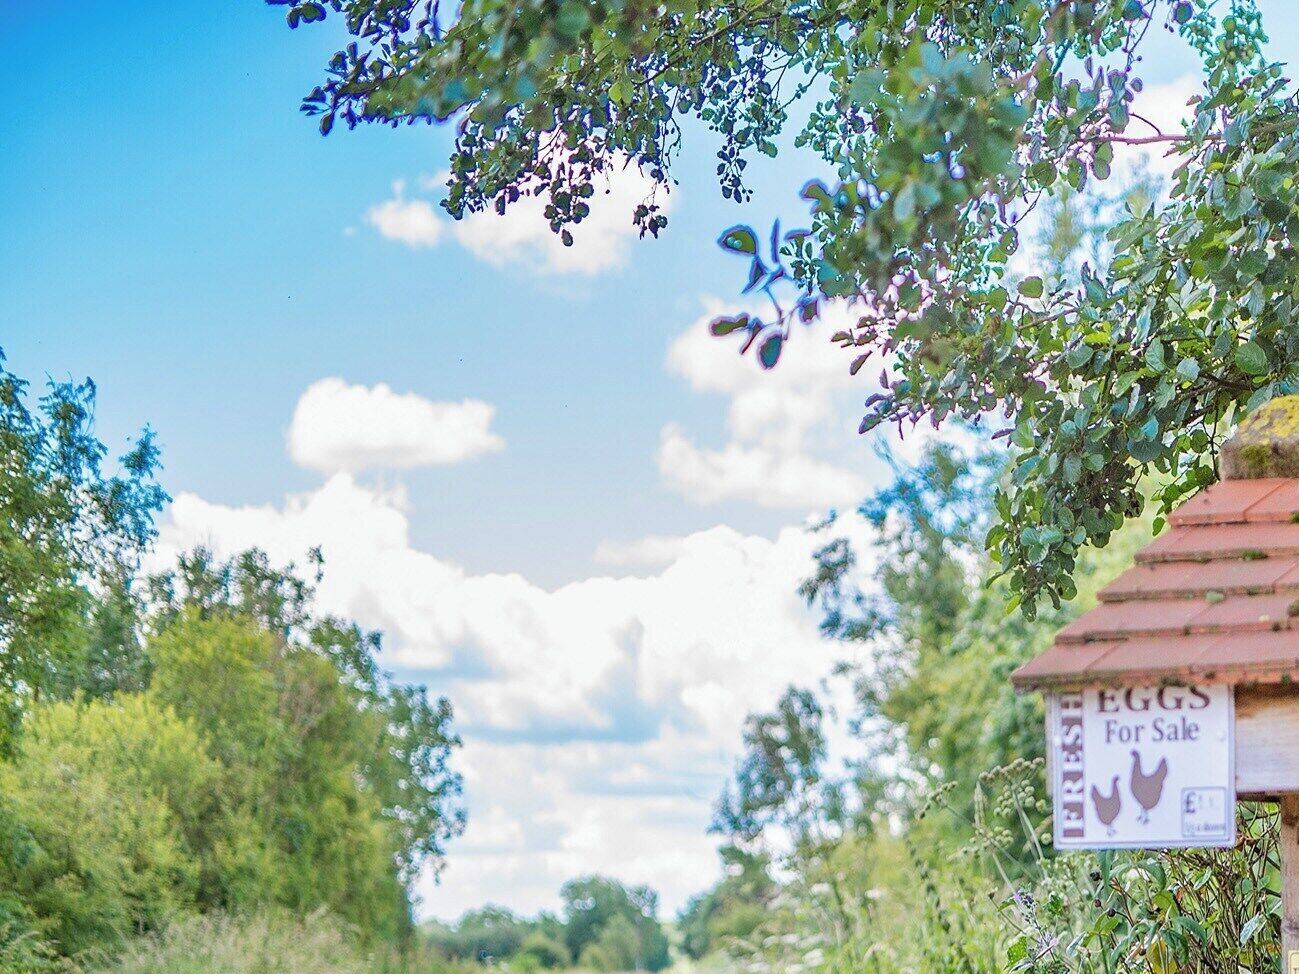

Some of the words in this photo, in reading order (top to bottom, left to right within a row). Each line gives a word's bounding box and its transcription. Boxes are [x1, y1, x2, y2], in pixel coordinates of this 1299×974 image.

[1097, 686, 1210, 713] EGGS
[1106, 719, 1145, 744] For
[1152, 716, 1200, 742] Sale
[1061, 694, 1084, 831] FRESH
